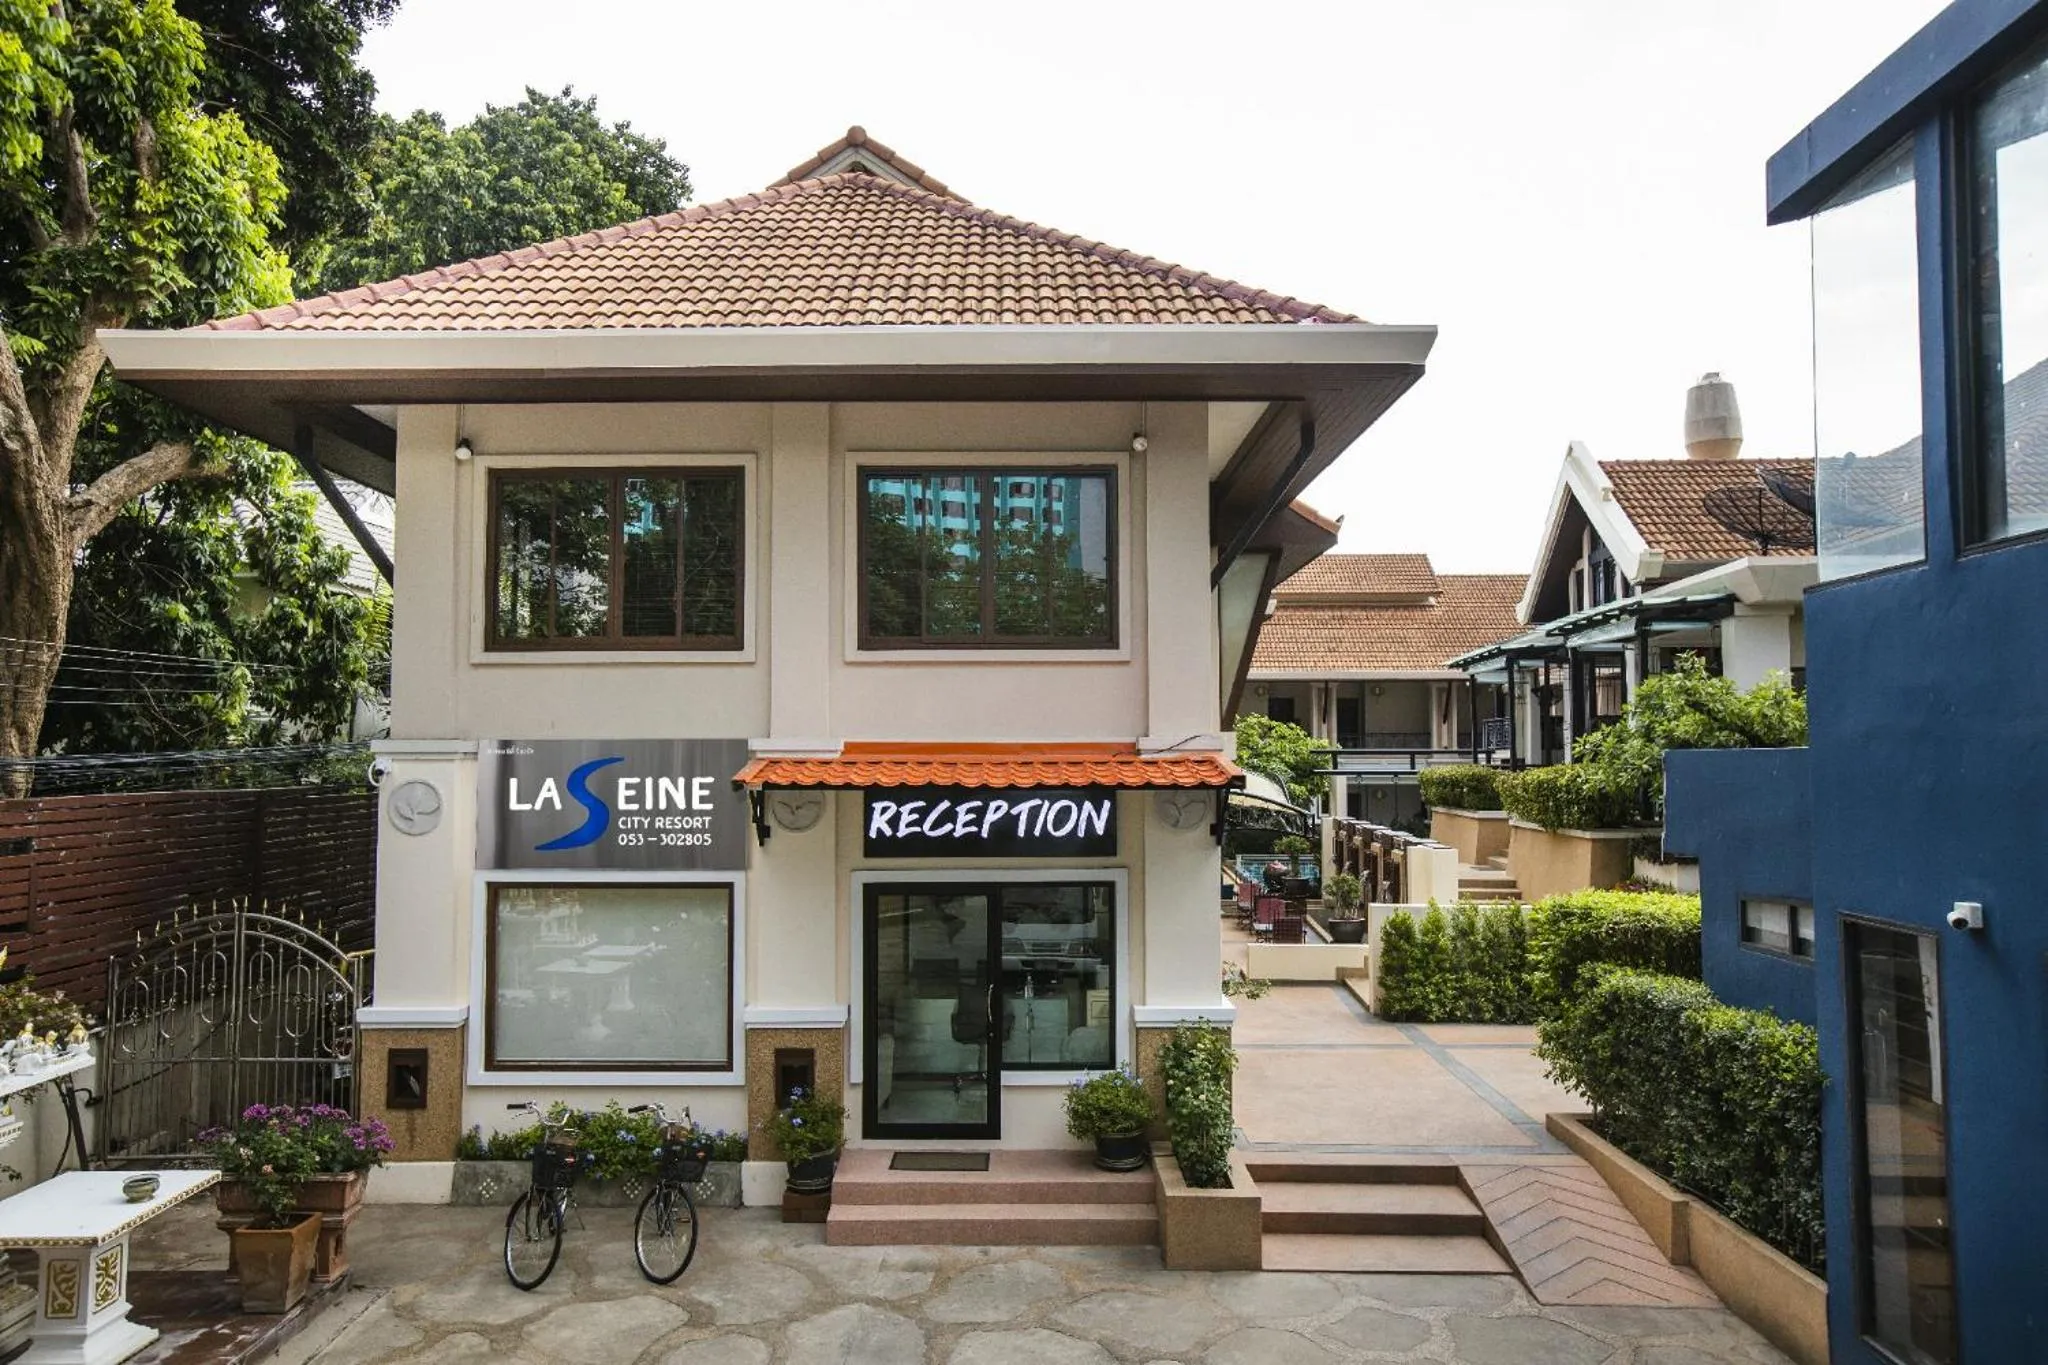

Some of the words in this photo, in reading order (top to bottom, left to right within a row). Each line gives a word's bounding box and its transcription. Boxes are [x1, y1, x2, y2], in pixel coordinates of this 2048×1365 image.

[508, 776, 562, 811] LA
[618, 816, 652, 829] CITY
[655, 816, 712, 829] RESORT
[868, 798, 1111, 839] RECEPTION
